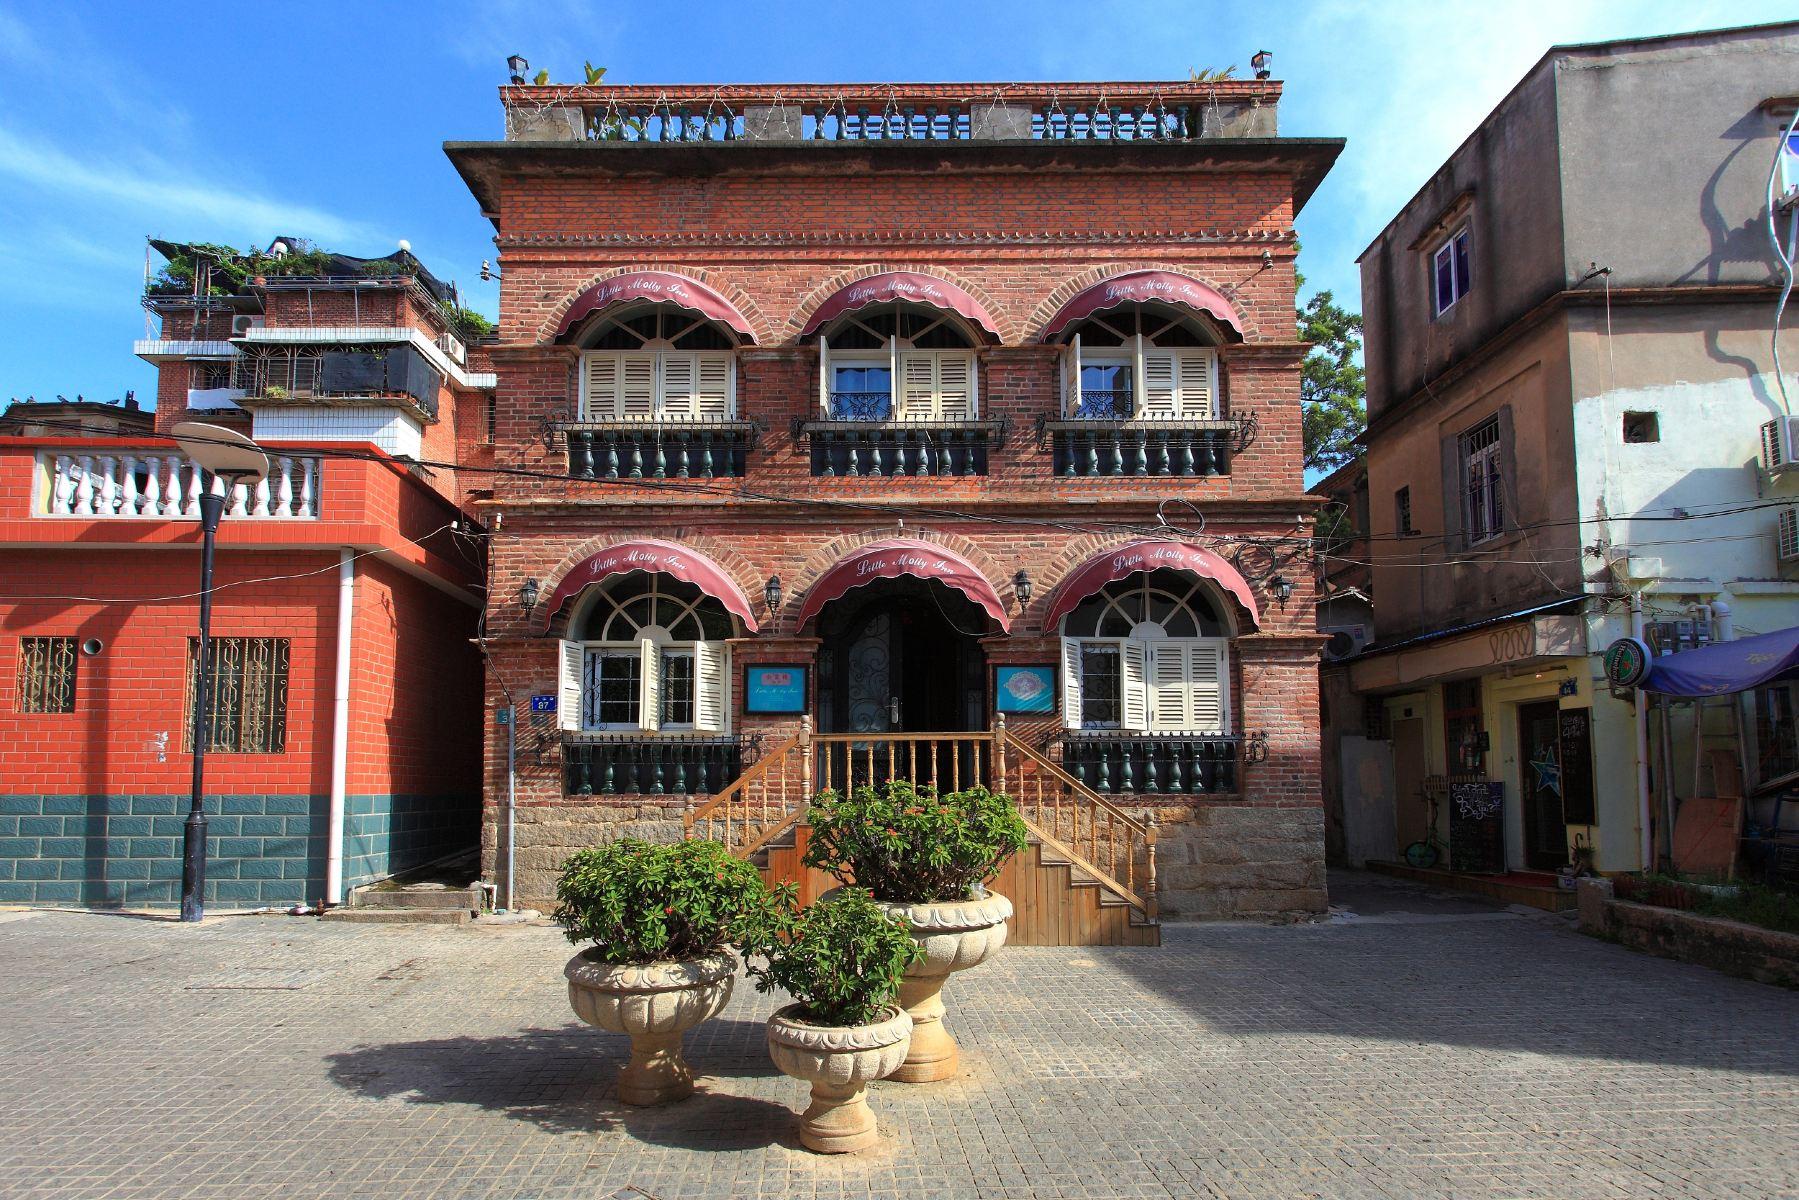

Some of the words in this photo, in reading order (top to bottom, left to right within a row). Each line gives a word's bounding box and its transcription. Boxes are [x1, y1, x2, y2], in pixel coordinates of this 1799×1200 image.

[628, 278, 662, 292] Molly
[667, 283, 689, 298] Inn
[882, 280, 916, 293] Molly
[921, 284, 943, 297] Inn
[1141, 279, 1174, 293] Molly
[1180, 284, 1200, 298] Inn
[623, 550, 657, 564] Molly
[664, 555, 687, 570] Inn
[857, 559, 886, 576] Little
[892, 554, 928, 569] Molly
[932, 560, 956, 574] Inn
[1149, 548, 1185, 562] Molly
[1190, 553, 1209, 567] Inn
[538, 701, 549, 710] 87
